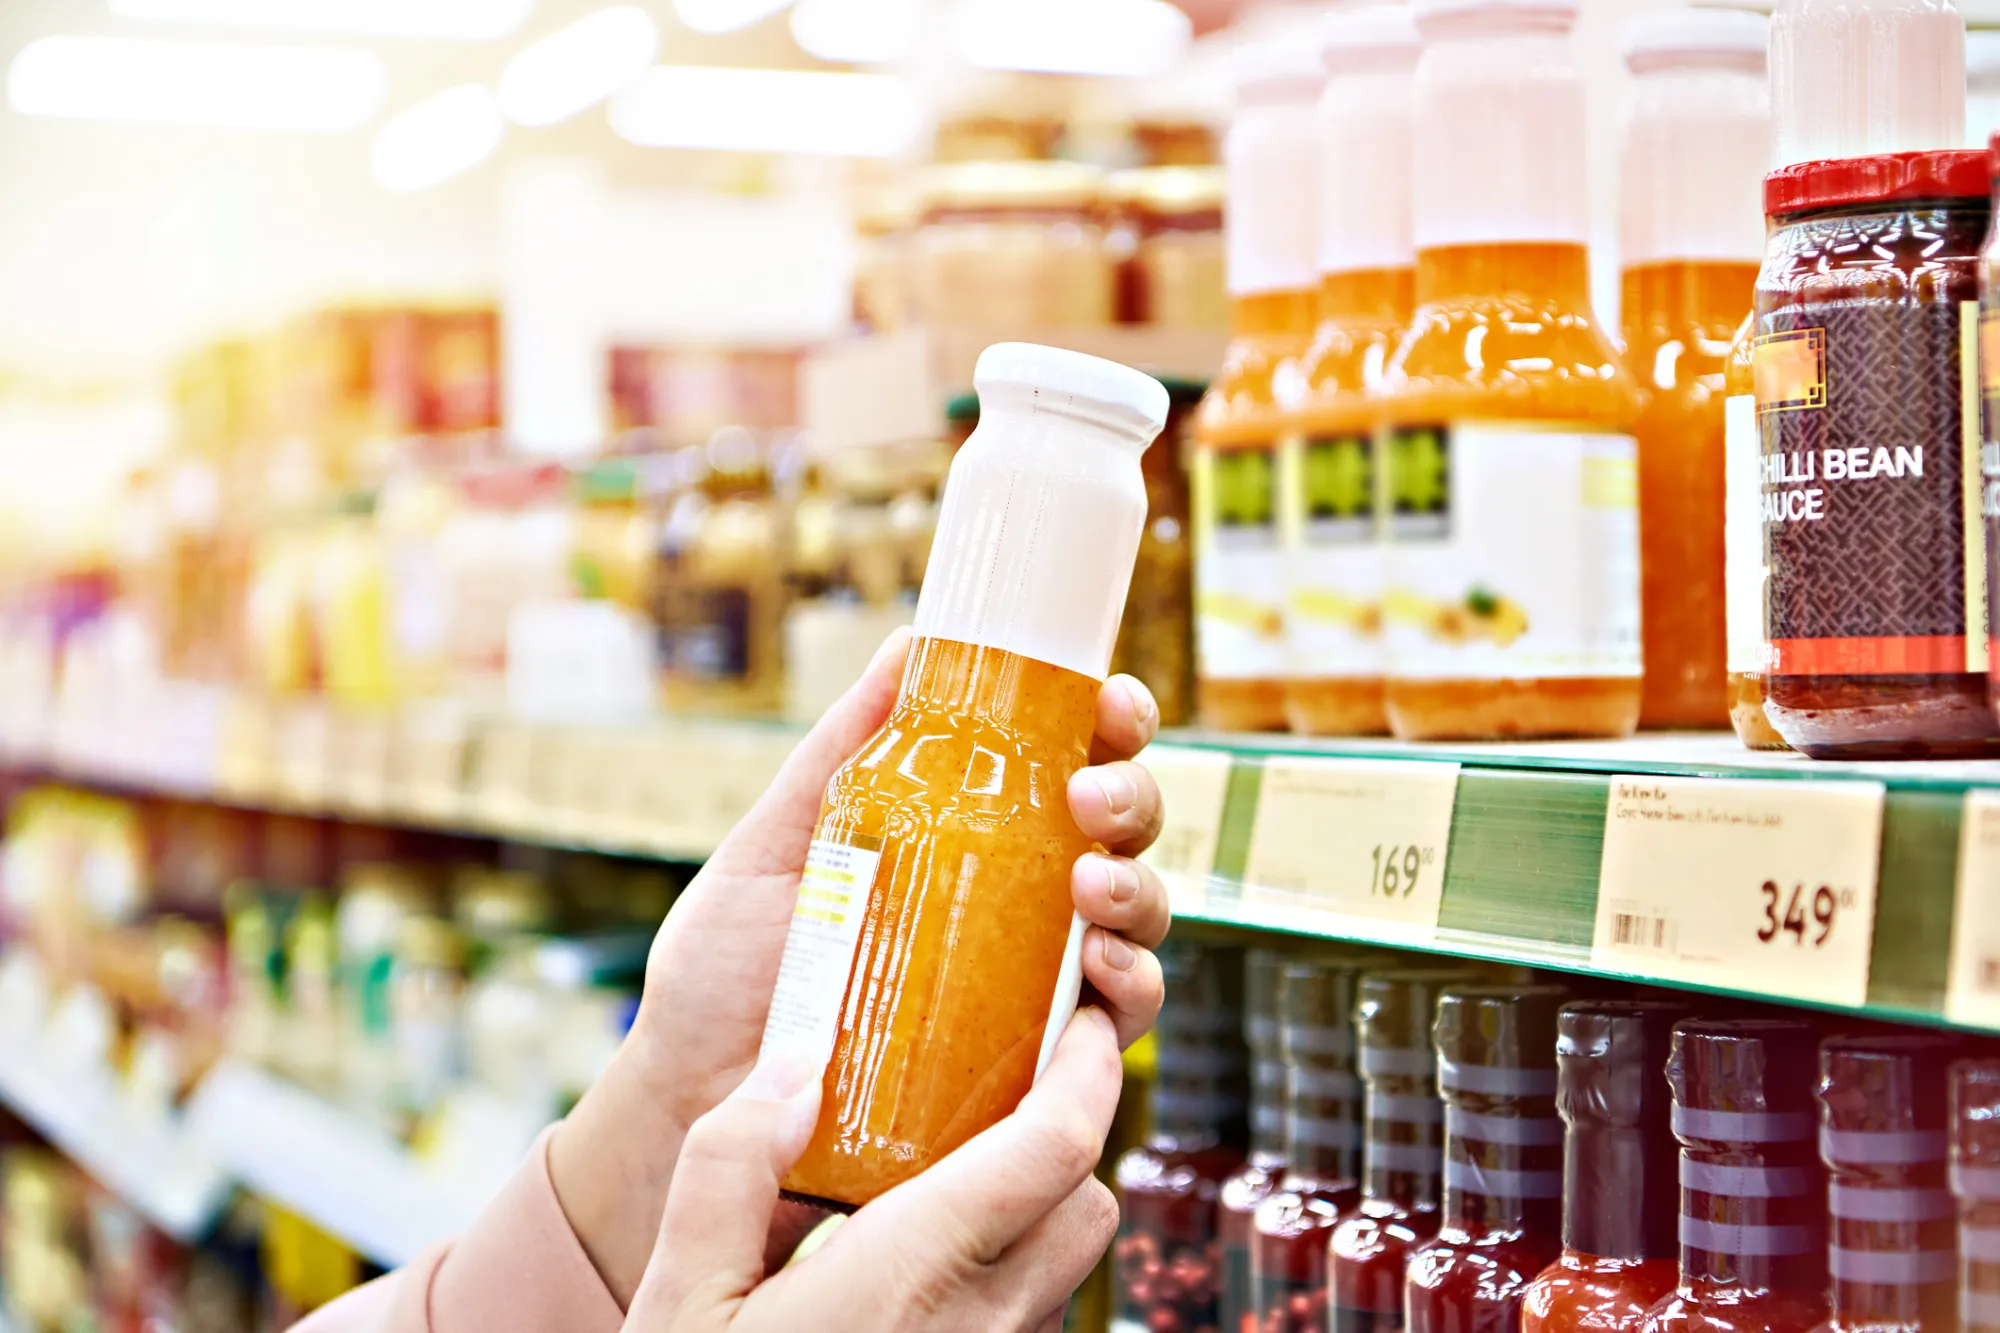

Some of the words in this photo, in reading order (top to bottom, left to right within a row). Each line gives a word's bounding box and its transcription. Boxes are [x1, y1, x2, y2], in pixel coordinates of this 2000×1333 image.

[1823, 445, 1924, 480] BEAN
[1371, 843, 1421, 899] 169
[1757, 879, 1836, 948] 349
